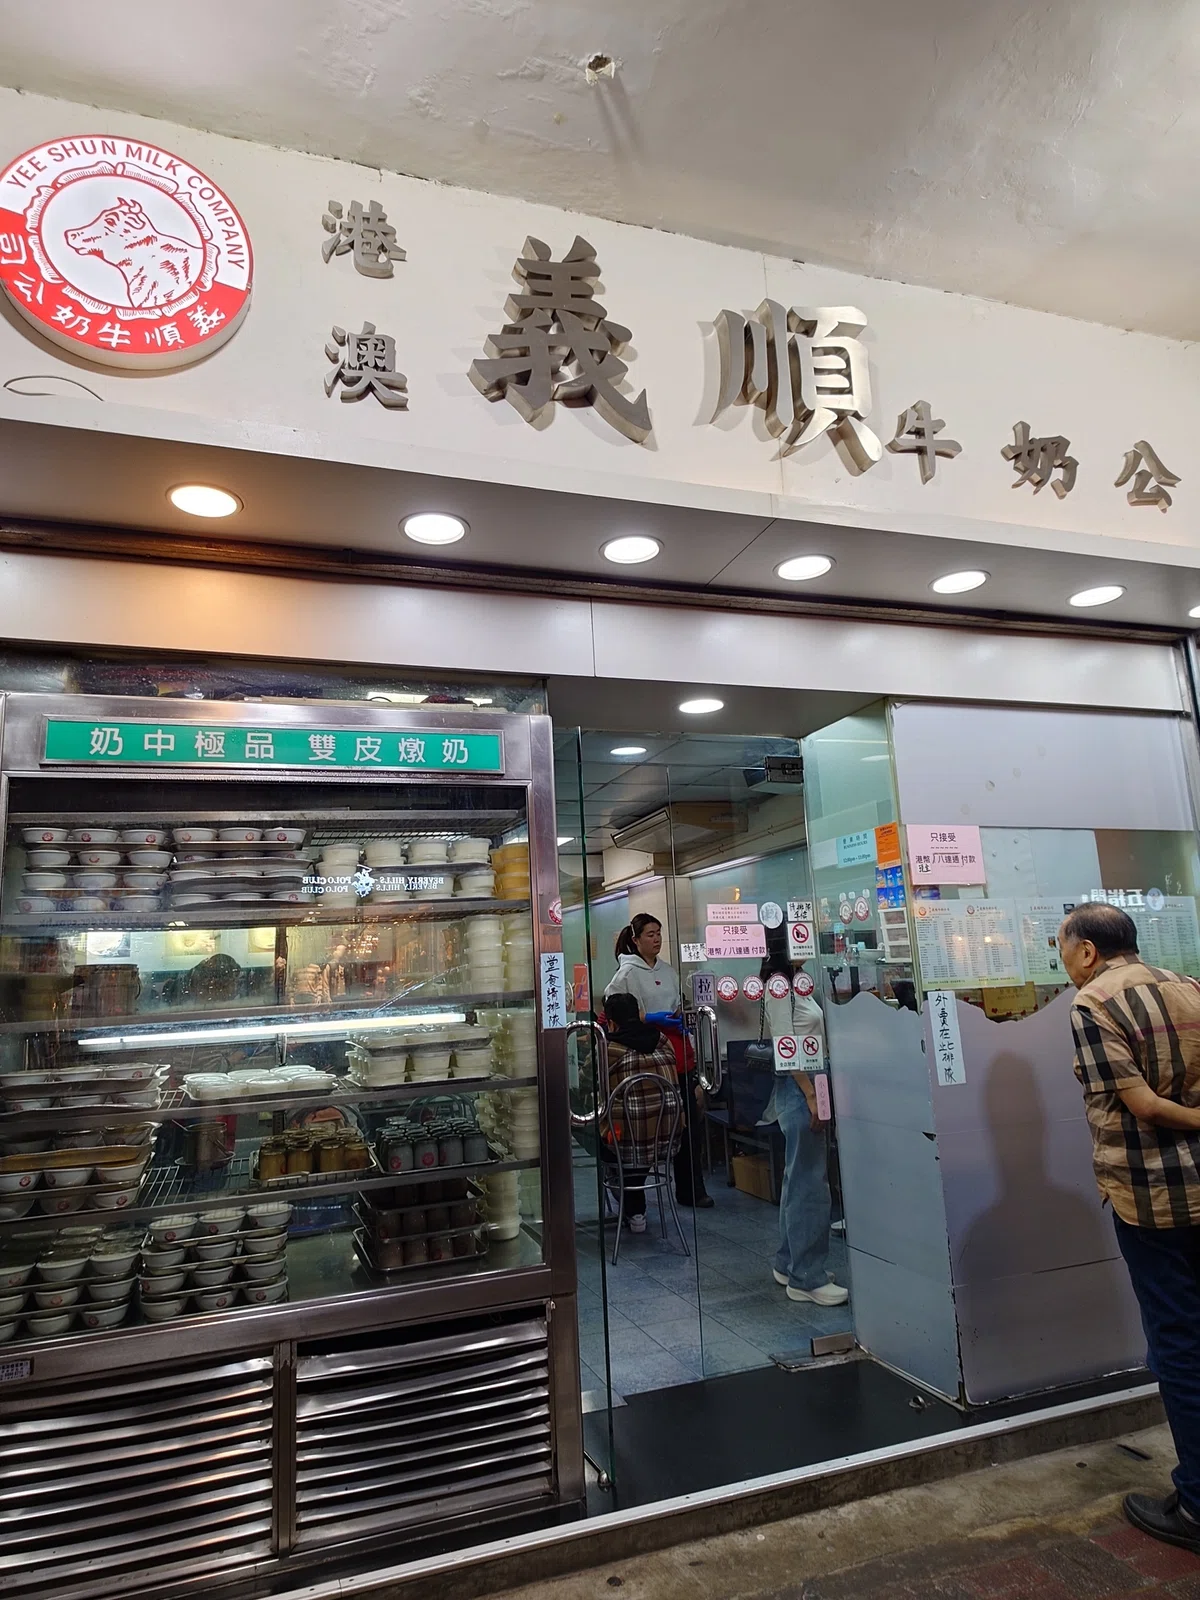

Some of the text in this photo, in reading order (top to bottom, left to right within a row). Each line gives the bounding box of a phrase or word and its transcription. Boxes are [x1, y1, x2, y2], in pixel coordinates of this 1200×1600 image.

[7, 139, 246, 270] YEE SHUN MILK COMPANY
[930, 832, 956, 843] 只接受
[722, 925, 748, 936] 只接受
[699, 978, 712, 994] 拉
[697, 994, 713, 1002] PULL
[935, 992, 957, 1084] 外賣在此排隊
